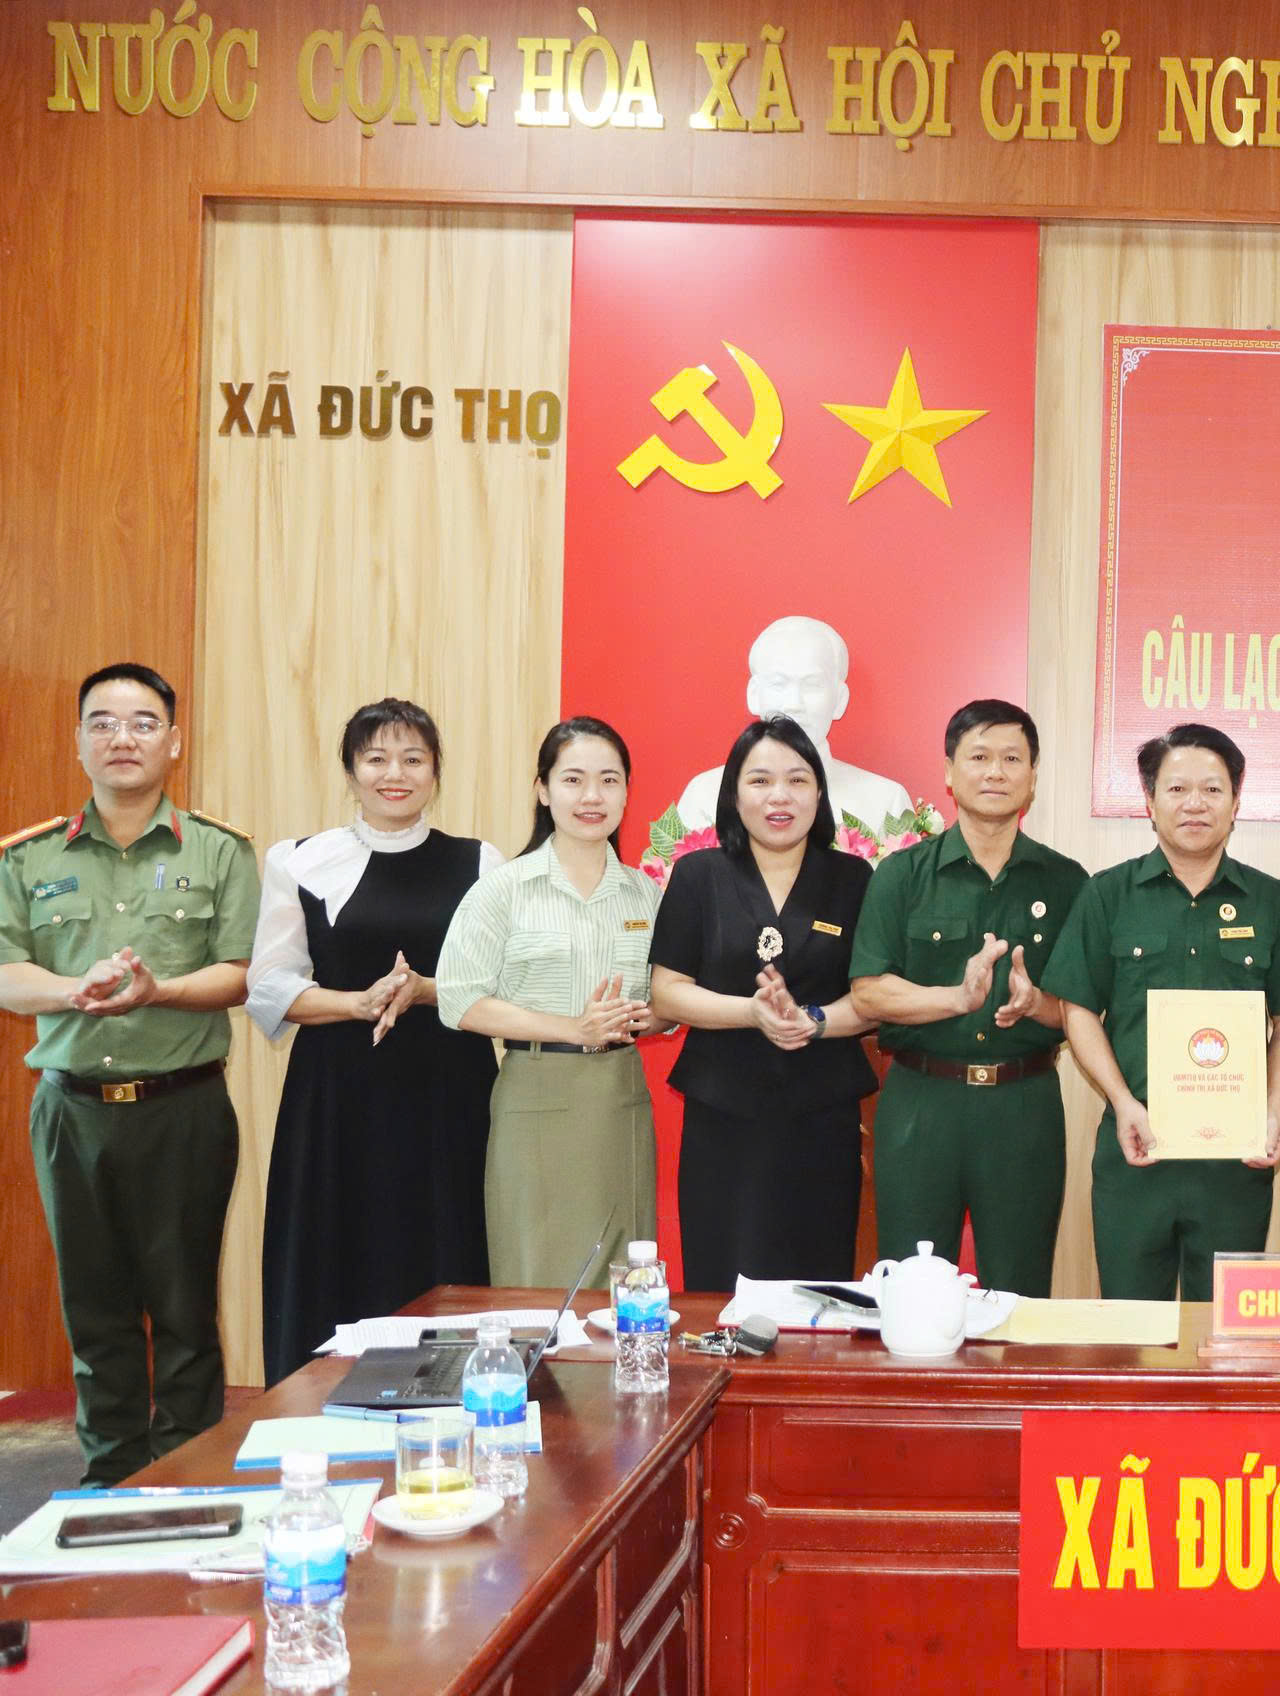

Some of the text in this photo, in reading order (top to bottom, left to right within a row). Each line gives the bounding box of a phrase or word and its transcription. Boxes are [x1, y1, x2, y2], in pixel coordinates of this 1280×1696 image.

[47, 0, 258, 121] NƯỚC
[302, 4, 495, 138] CỘNG
[515, 6, 664, 128] HÒA
[690, 24, 801, 133] XÃ
[826, 20, 954, 152] HỘI
[980, 29, 1131, 145] CHỦ
[218, 369, 562, 460] XÃ ĐỨC THỌ
[1142, 614, 1212, 709] CÂU
[1053, 1454, 1154, 1589] XÃ
